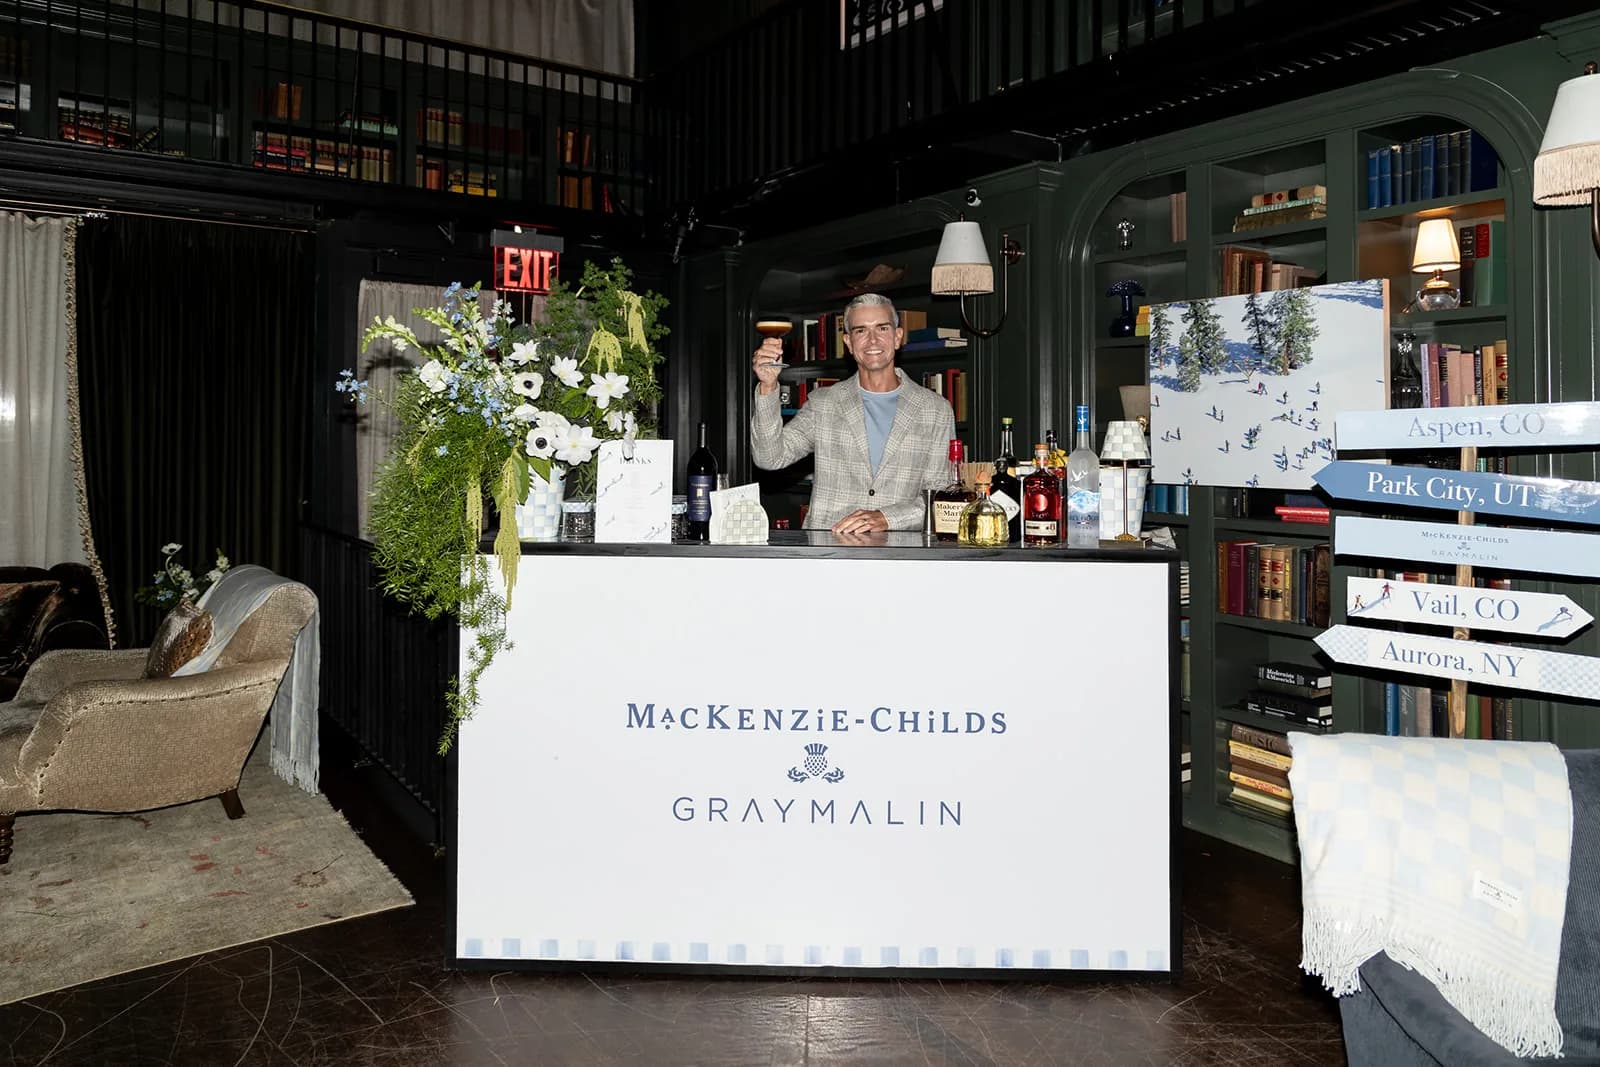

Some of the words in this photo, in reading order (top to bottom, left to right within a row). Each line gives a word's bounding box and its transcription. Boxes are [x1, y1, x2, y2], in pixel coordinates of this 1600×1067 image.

[503, 247, 553, 291] EXIT
[1408, 415, 1492, 443] Aspen,
[1500, 412, 1545, 435] CO
[1367, 471, 1420, 496] Park
[1426, 477, 1485, 508] City,
[1494, 483, 1537, 507] UT
[1410, 590, 1467, 619] Vail,
[1475, 596, 1520, 621] CO
[1382, 640, 1473, 675] Aurora,
[1482, 652, 1524, 678] NY
[672, 796, 962, 826] GRAYMALIN
